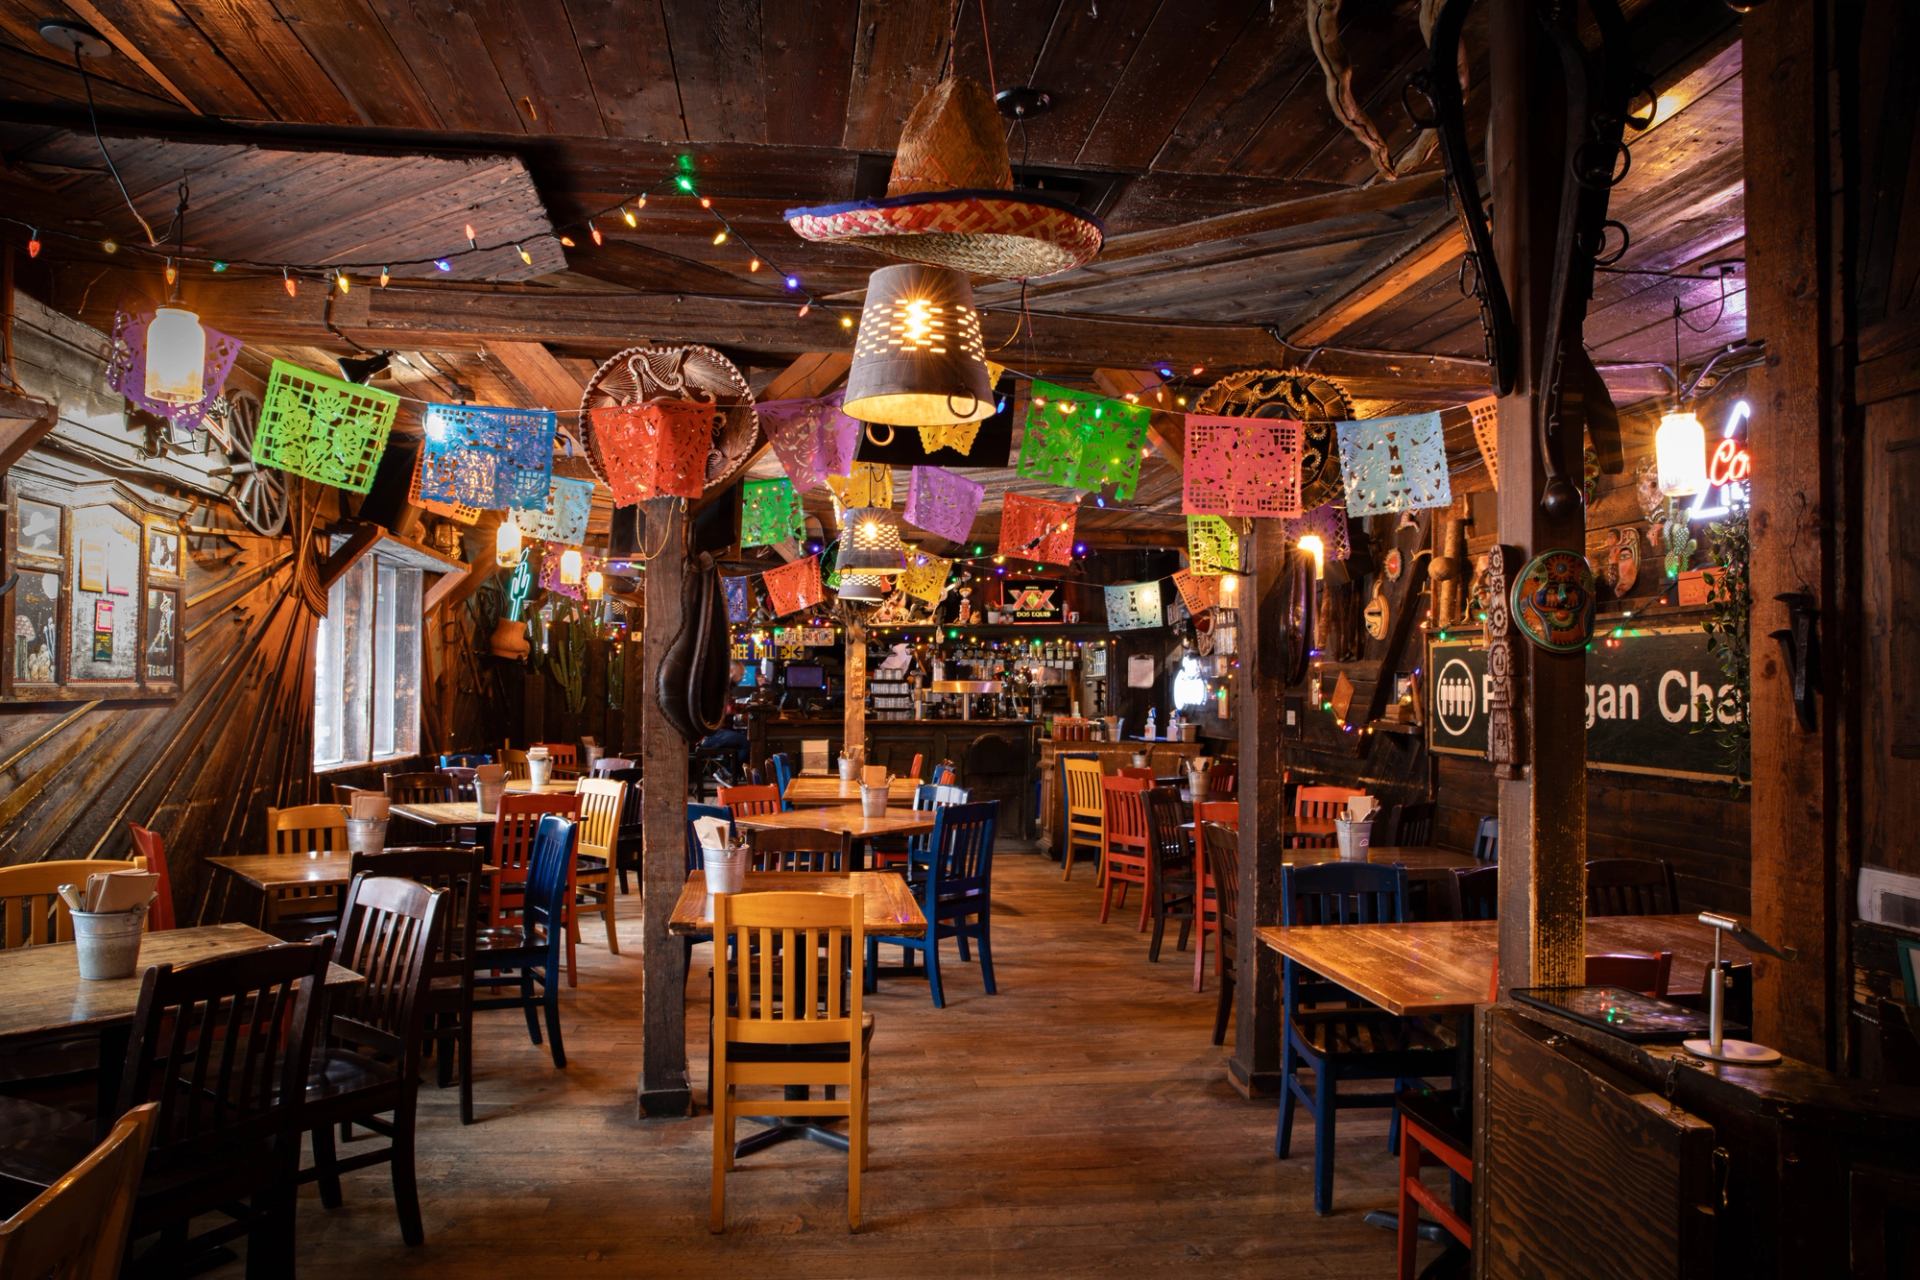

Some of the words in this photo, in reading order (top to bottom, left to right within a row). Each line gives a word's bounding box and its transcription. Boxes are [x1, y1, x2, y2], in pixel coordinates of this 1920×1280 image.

[1710, 438, 1751, 486] Co
[1009, 589, 1056, 611] XX
[1016, 611, 1030, 619] DOS
[1031, 611, 1051, 619] EQUIS
[729, 644, 748, 660] REE
[754, 644, 775, 660] FALL
[1658, 669, 1751, 725] Cha
